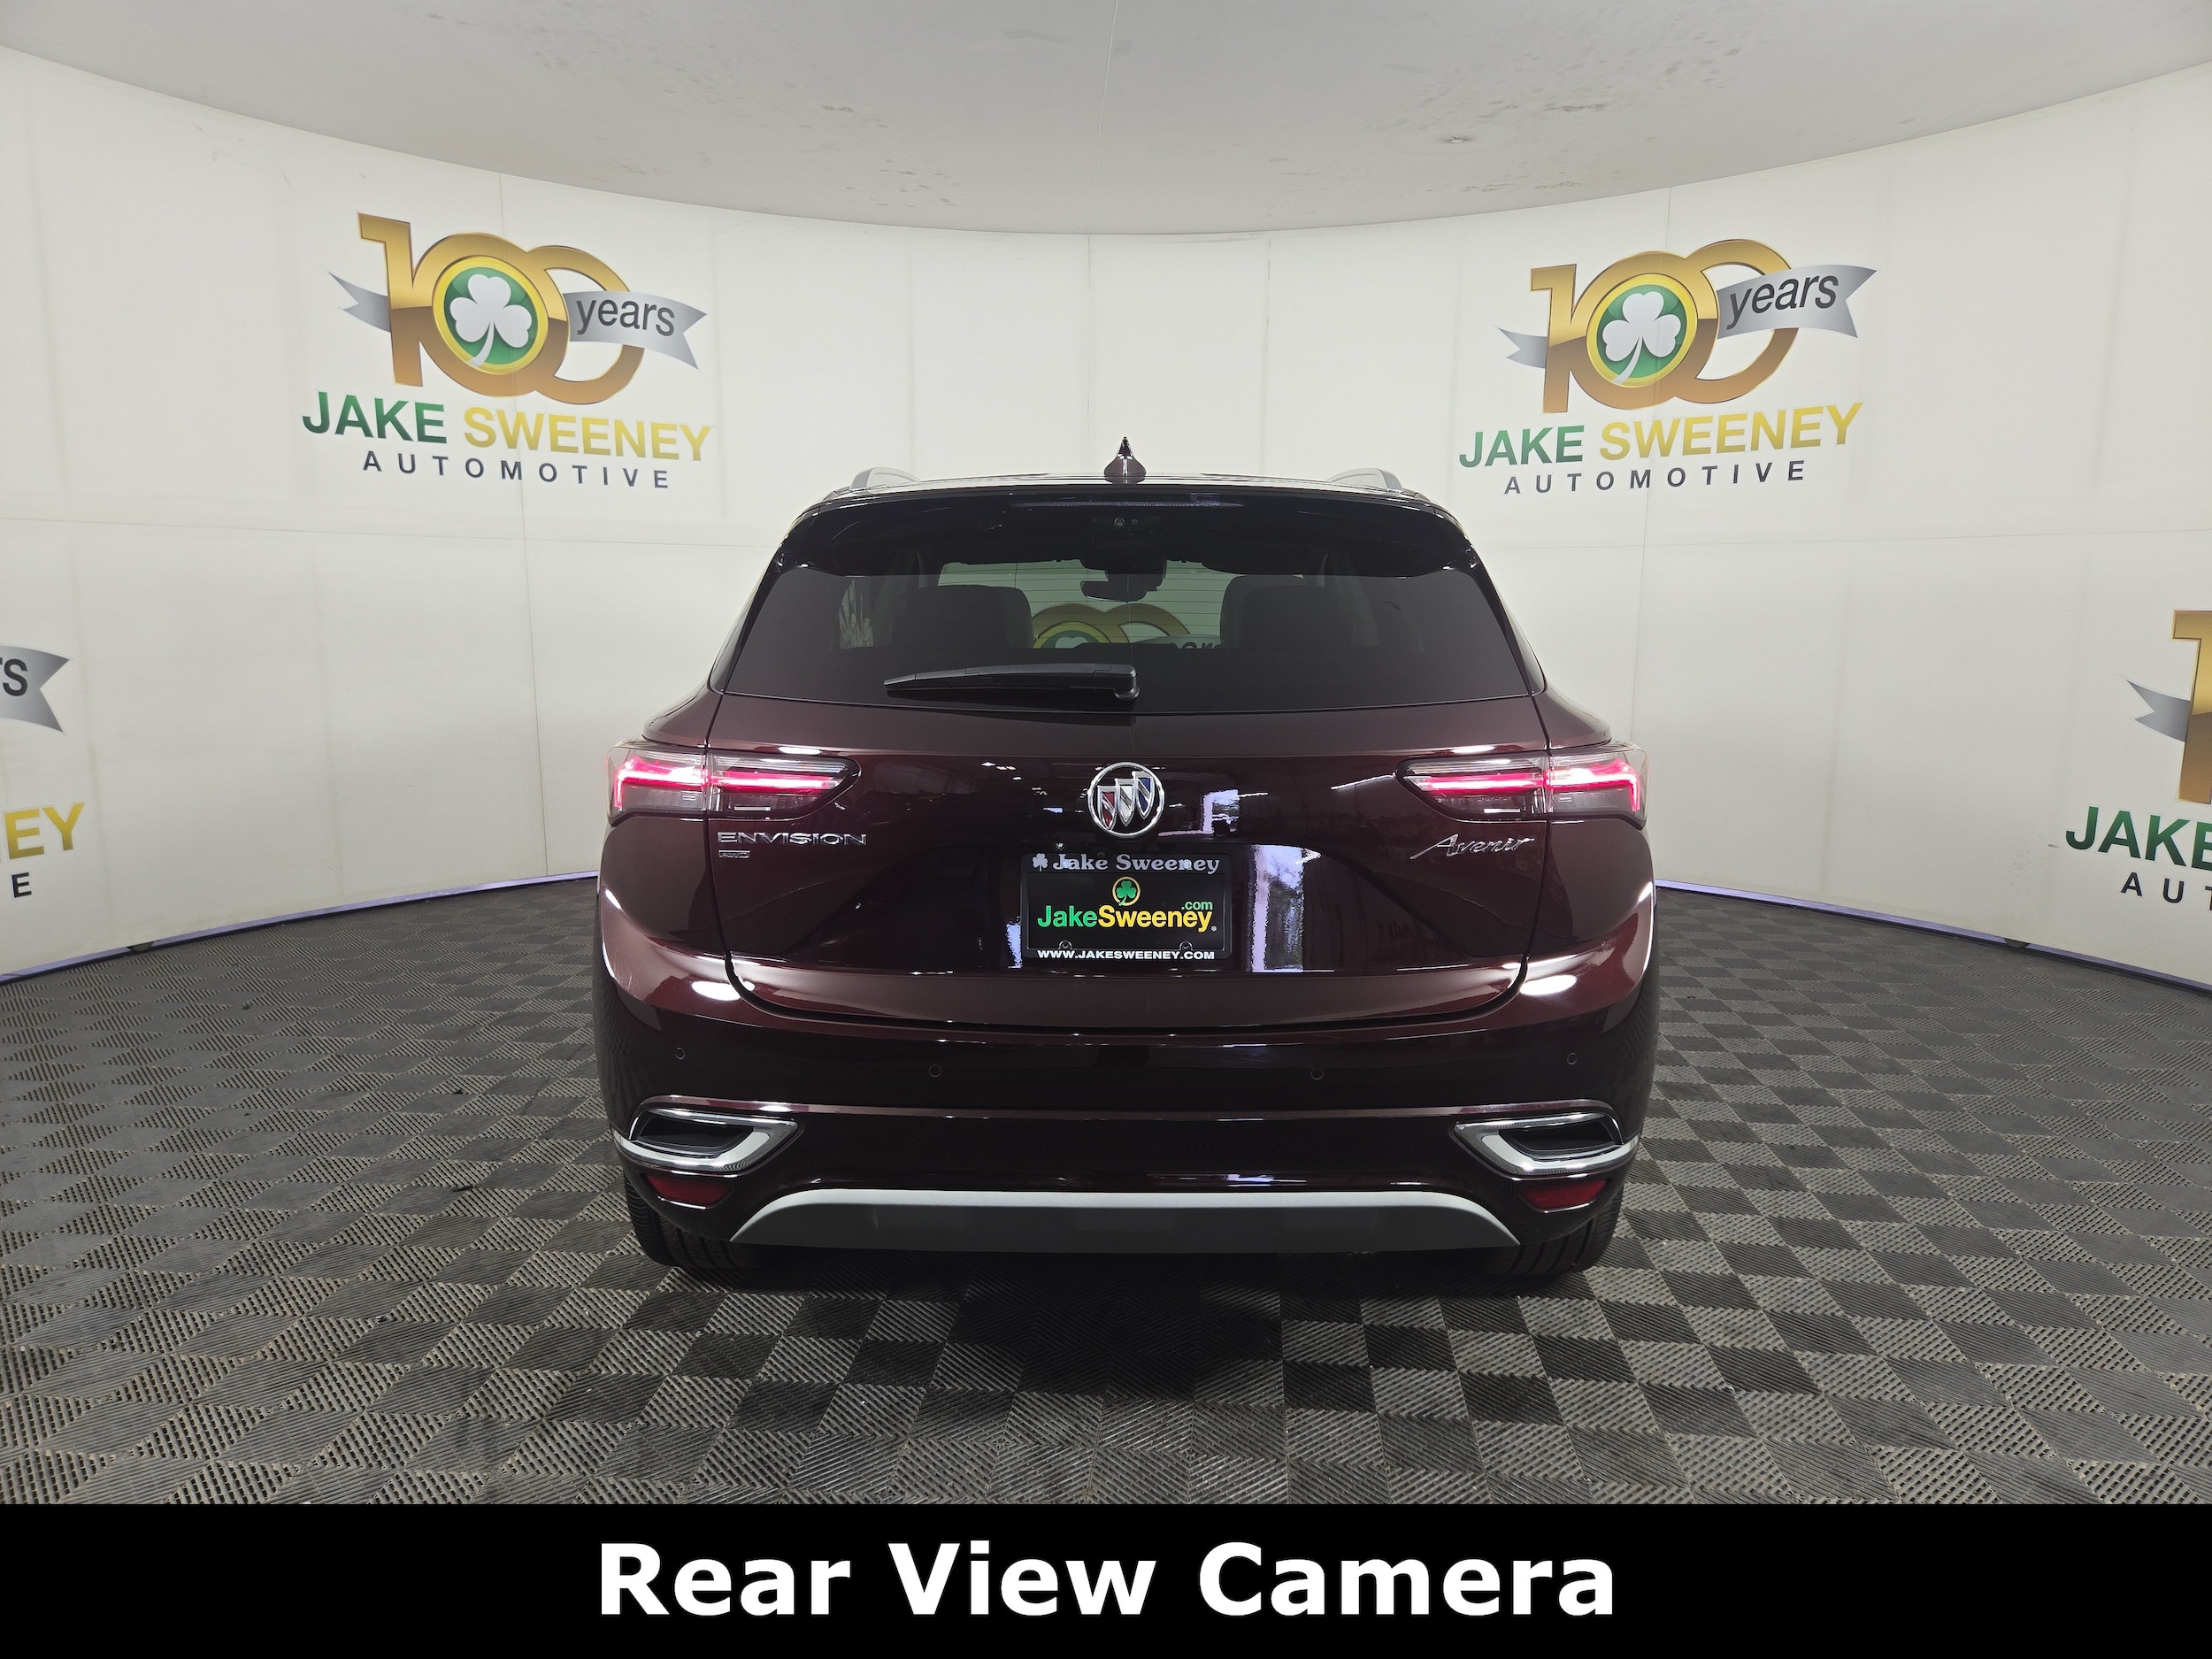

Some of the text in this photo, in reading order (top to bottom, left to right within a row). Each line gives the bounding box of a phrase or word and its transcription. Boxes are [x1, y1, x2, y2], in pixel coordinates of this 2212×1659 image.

[357, 212, 675, 405] 100 years
[1531, 238, 1839, 413] 100 years
[303, 391, 711, 462] JAKE SWEENEY
[1459, 401, 1863, 468] JAKE SWEENEY
[363, 450, 668, 489] AUTOMOTIVE
[1504, 459, 1804, 495] AUTOMOTIVE
[718, 832, 867, 846] ENVISION
[1409, 833, 1535, 859] Avenir
[1053, 854, 1220, 874] Jake Sweeney
[1037, 950, 1215, 960] WWW.JAKESWEENEY.COM
